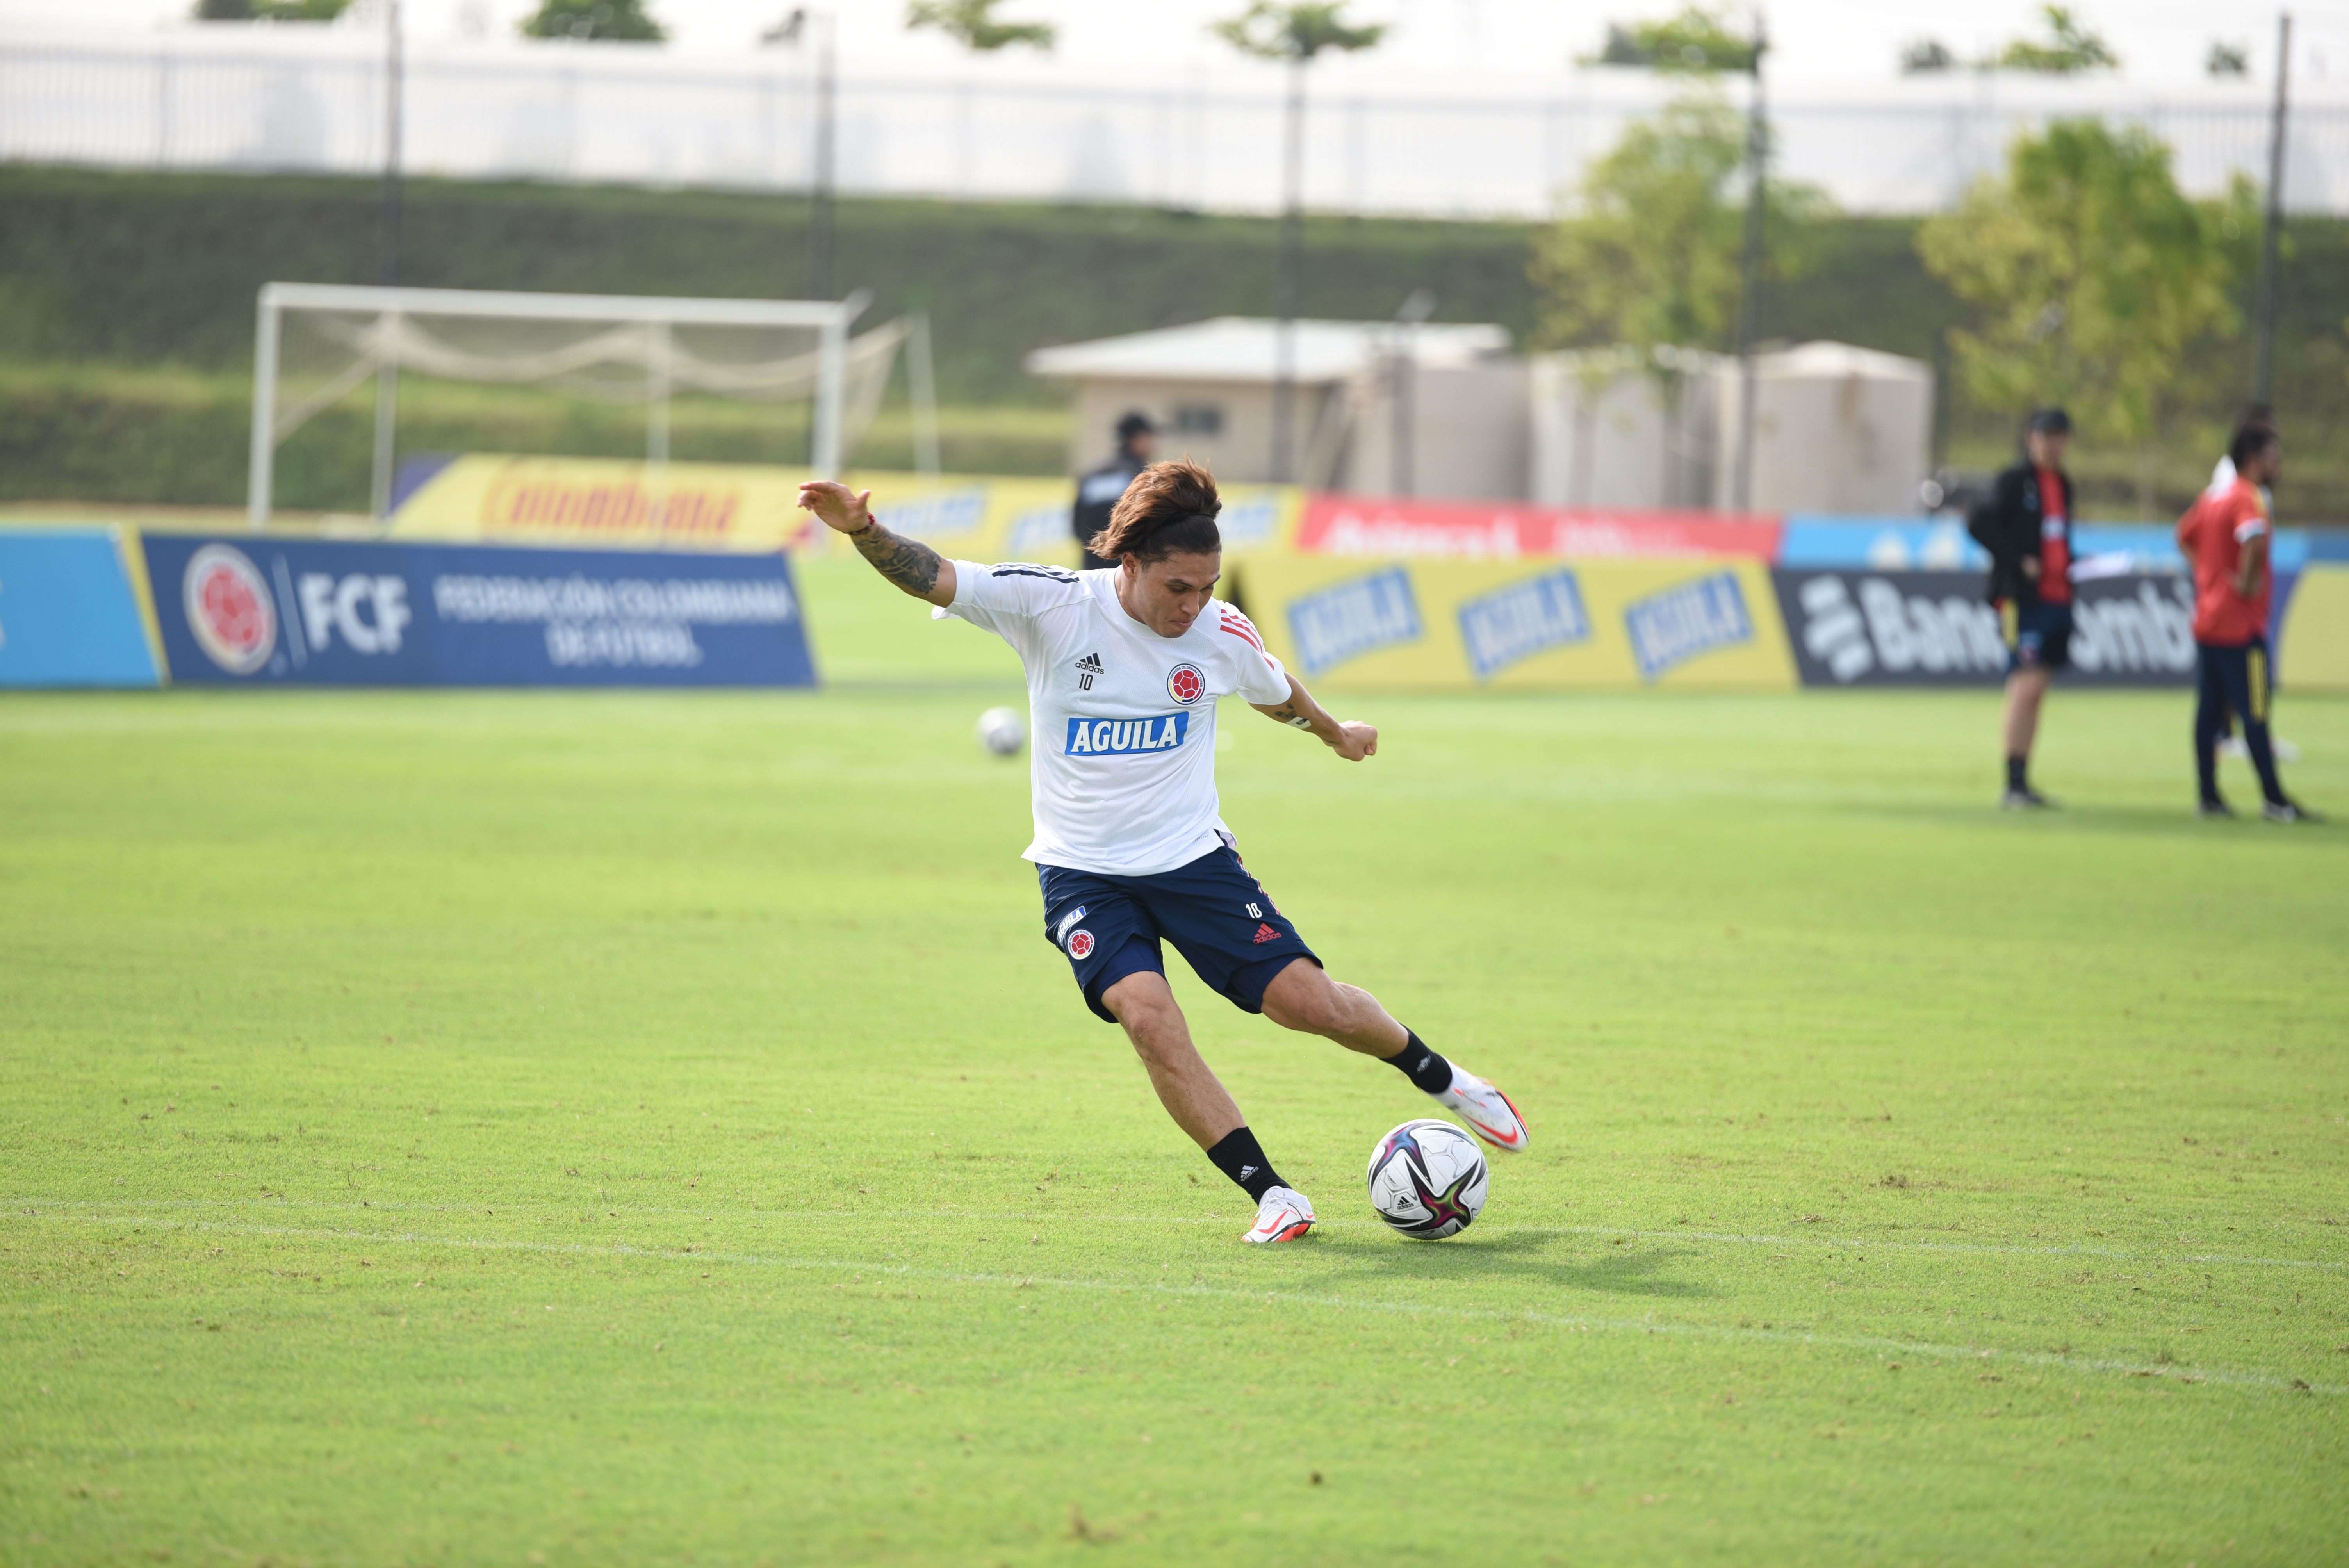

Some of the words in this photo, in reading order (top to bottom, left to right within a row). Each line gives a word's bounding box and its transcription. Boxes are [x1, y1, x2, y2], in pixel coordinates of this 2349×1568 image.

[299, 572, 411, 653] FCF
[1075, 662, 1104, 674] adidas
[1079, 673, 1093, 691] 10
[1070, 716, 1178, 752] AGUILA
[1245, 903, 1262, 918] 10
[1058, 909, 1084, 941] AGUILA
[1253, 932, 1282, 944] adidas
[1240, 1166, 1259, 1181] adidas
